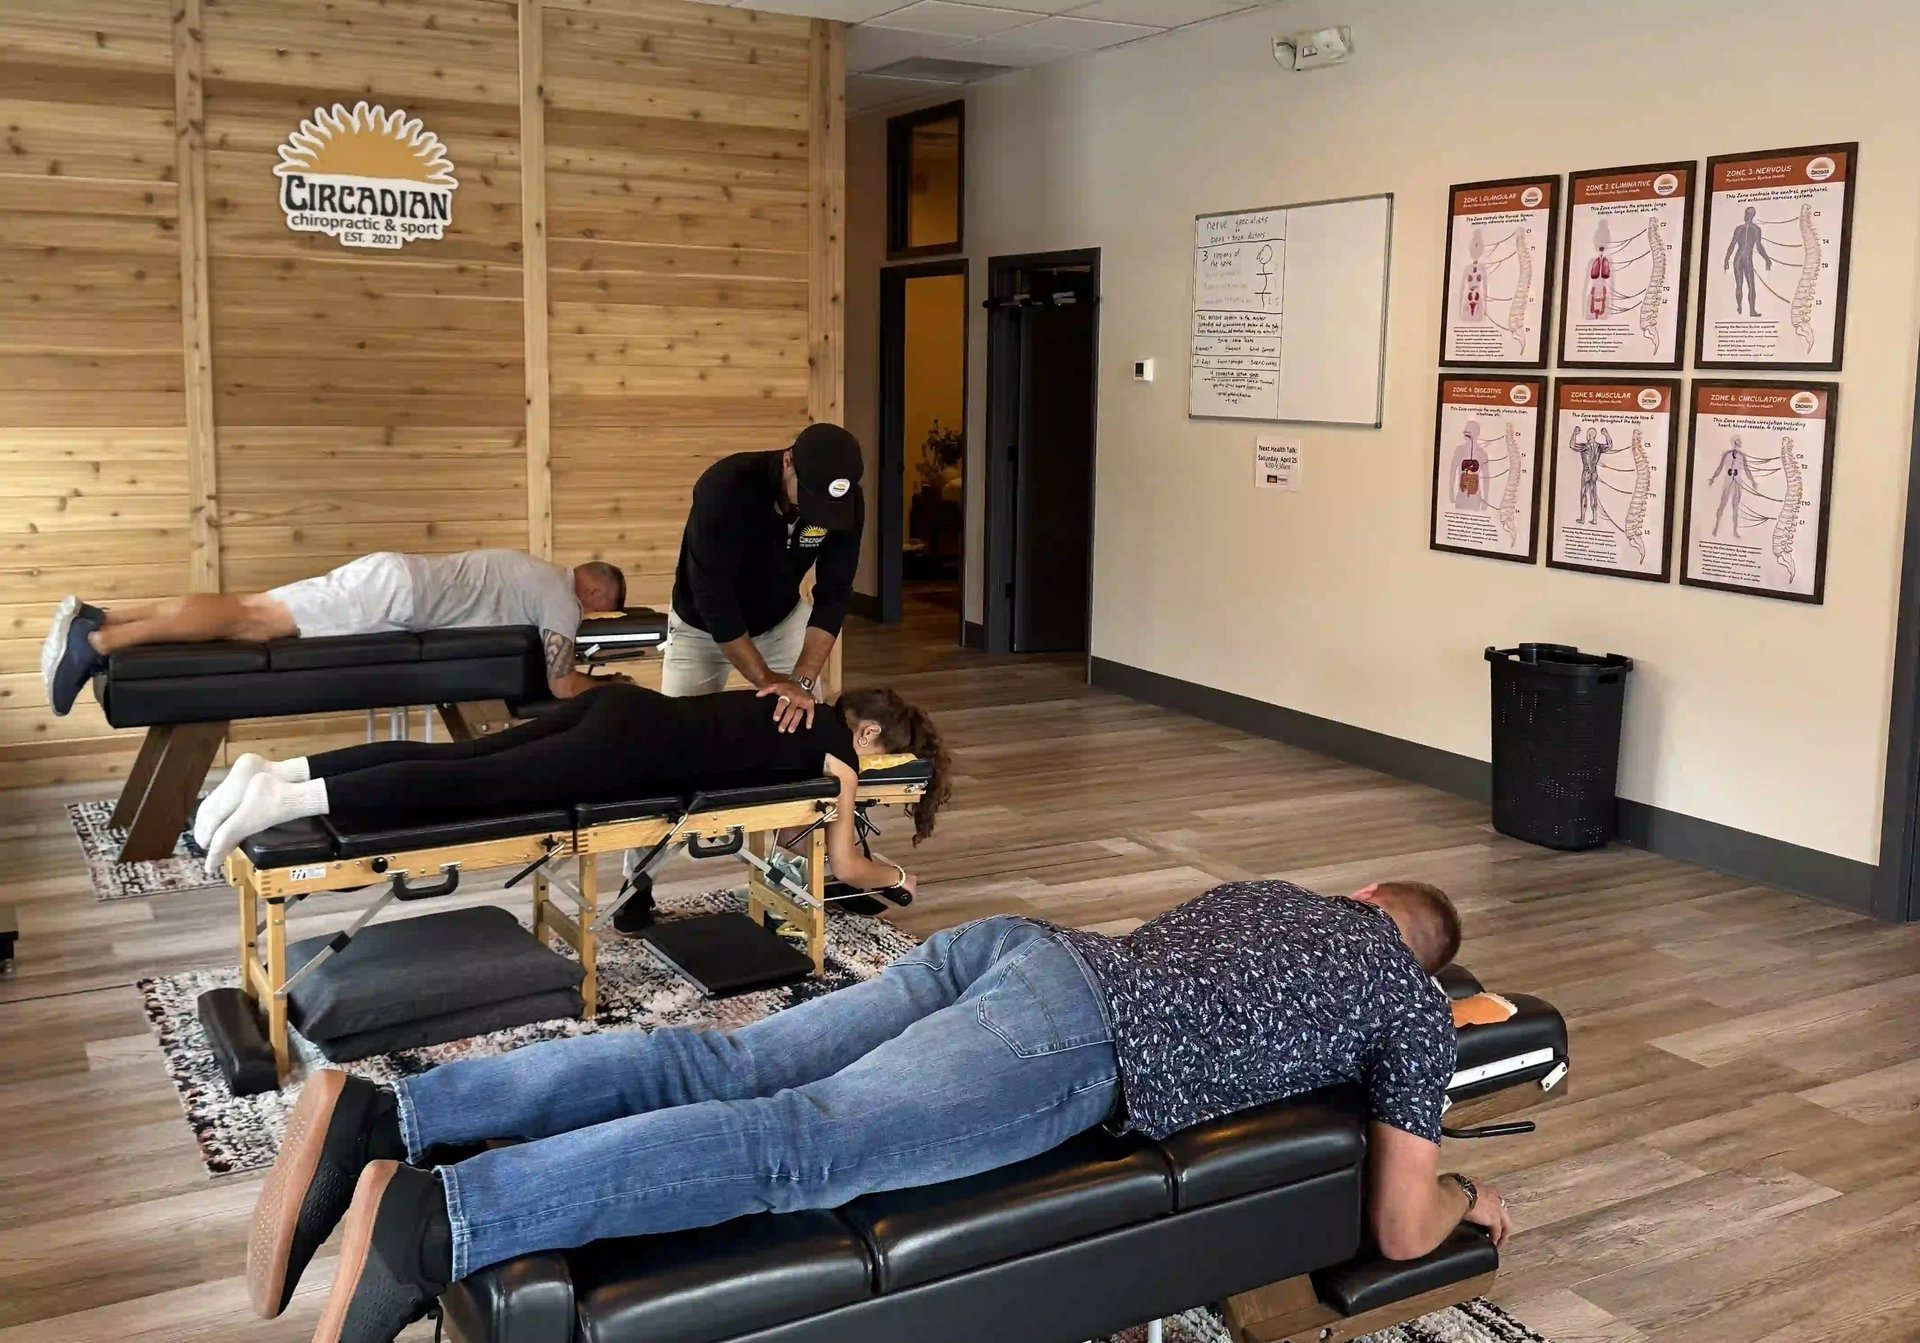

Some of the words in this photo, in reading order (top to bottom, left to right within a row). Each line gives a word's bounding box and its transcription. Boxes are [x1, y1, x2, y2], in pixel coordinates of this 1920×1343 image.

[1756, 165, 1792, 174] NERVOUS
[1611, 180, 1651, 189] ELIMINATIVE
[285, 174, 448, 221] CIRCADIAN
[1484, 193, 1516, 201] GLANDULAR
[292, 213, 380, 231] chiropractic
[385, 219, 396, 231] &
[401, 222, 439, 235] sport
[1207, 221, 1227, 230] nerve
[344, 232, 365, 243] EST.
[372, 234, 398, 244] 2021
[1202, 251, 1208, 261] 3
